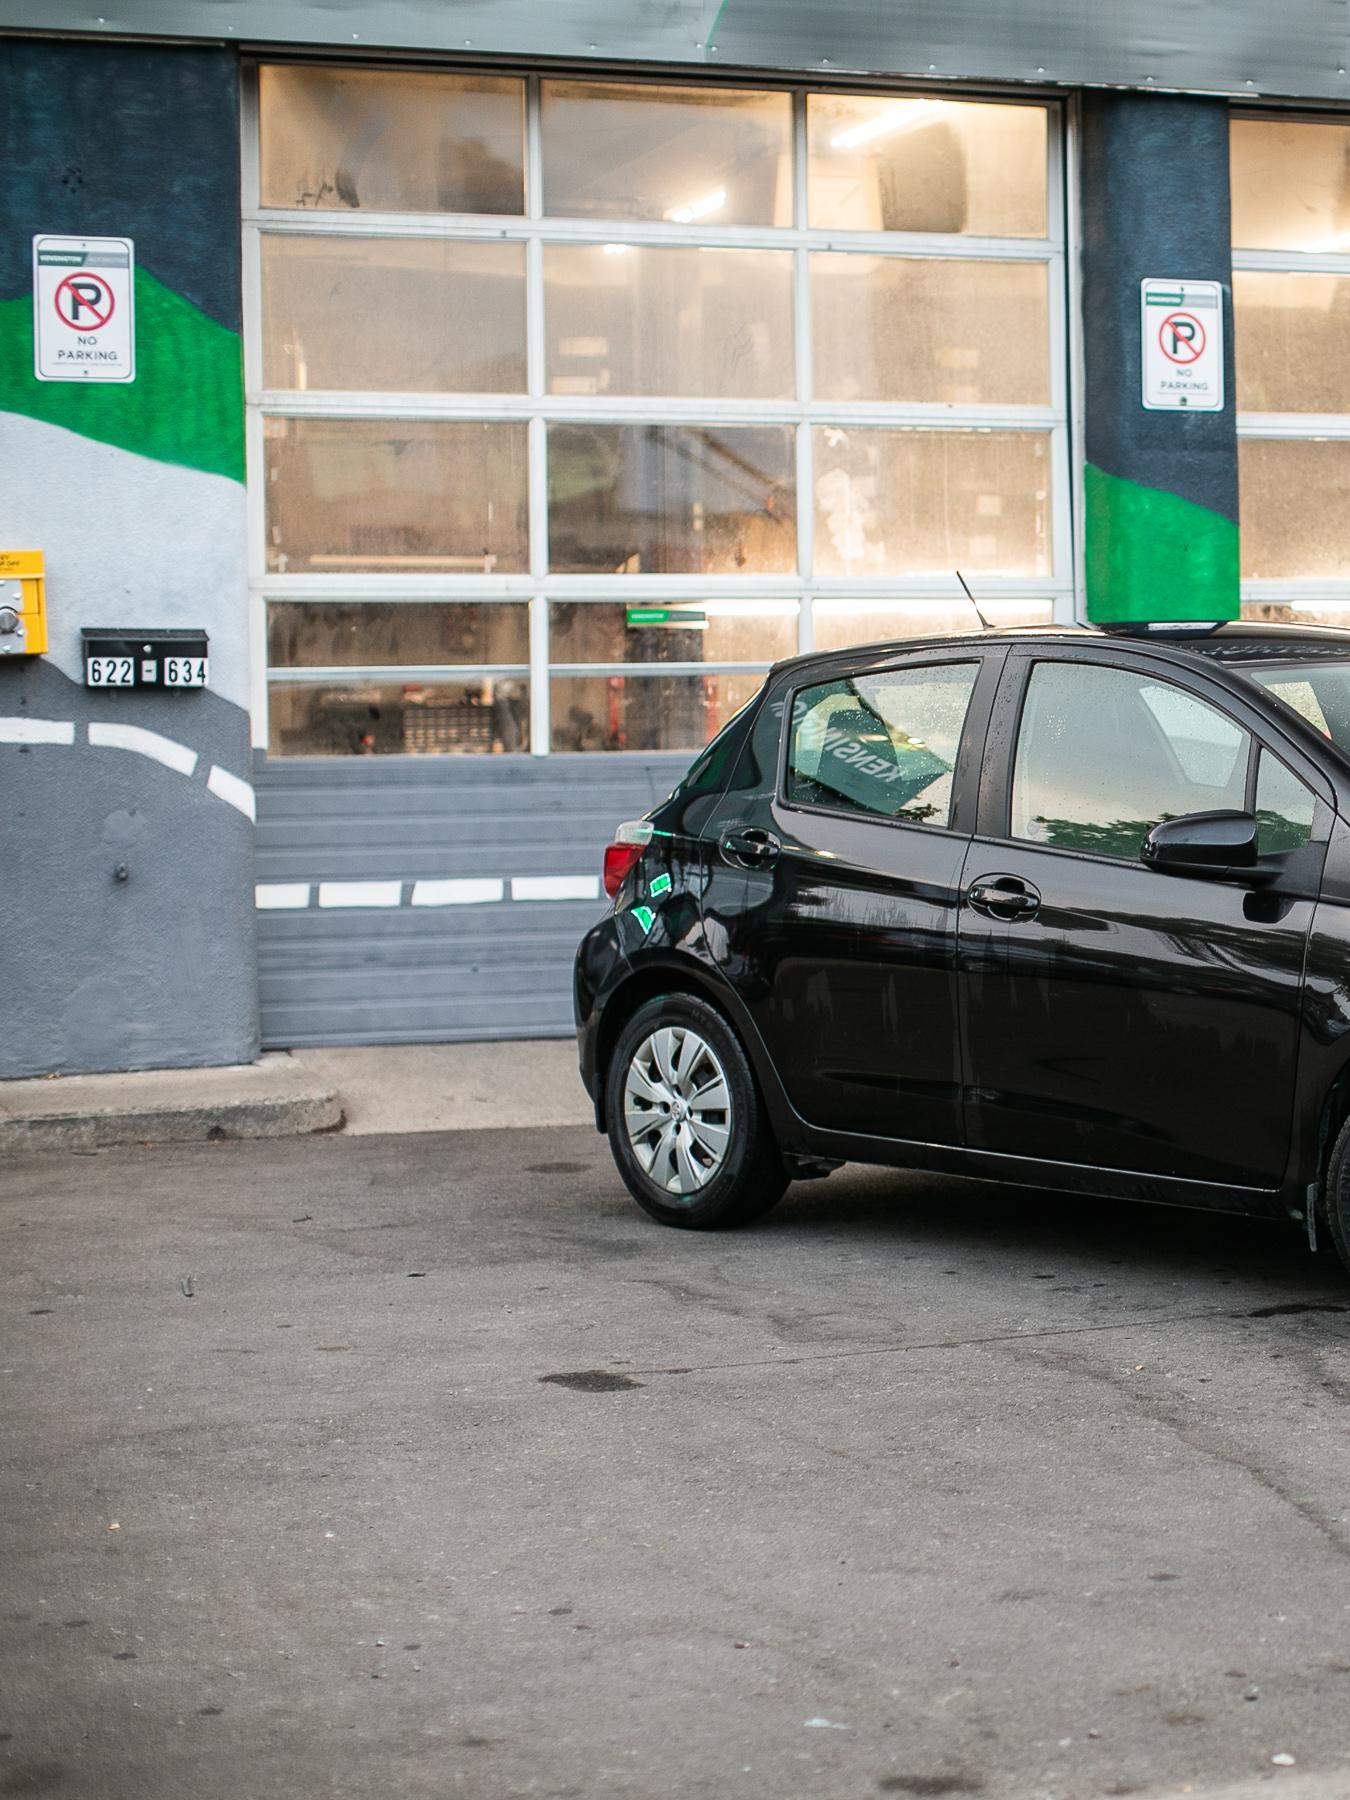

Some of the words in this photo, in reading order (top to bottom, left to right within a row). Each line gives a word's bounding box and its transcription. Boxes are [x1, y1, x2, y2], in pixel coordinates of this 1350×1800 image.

[77, 336, 97, 345] NO
[57, 350, 118, 361] PARKING
[1176, 369, 1192, 377] NO
[1160, 381, 1208, 391] PARKING
[92, 660, 131, 683] 622
[168, 660, 206, 684] 634
